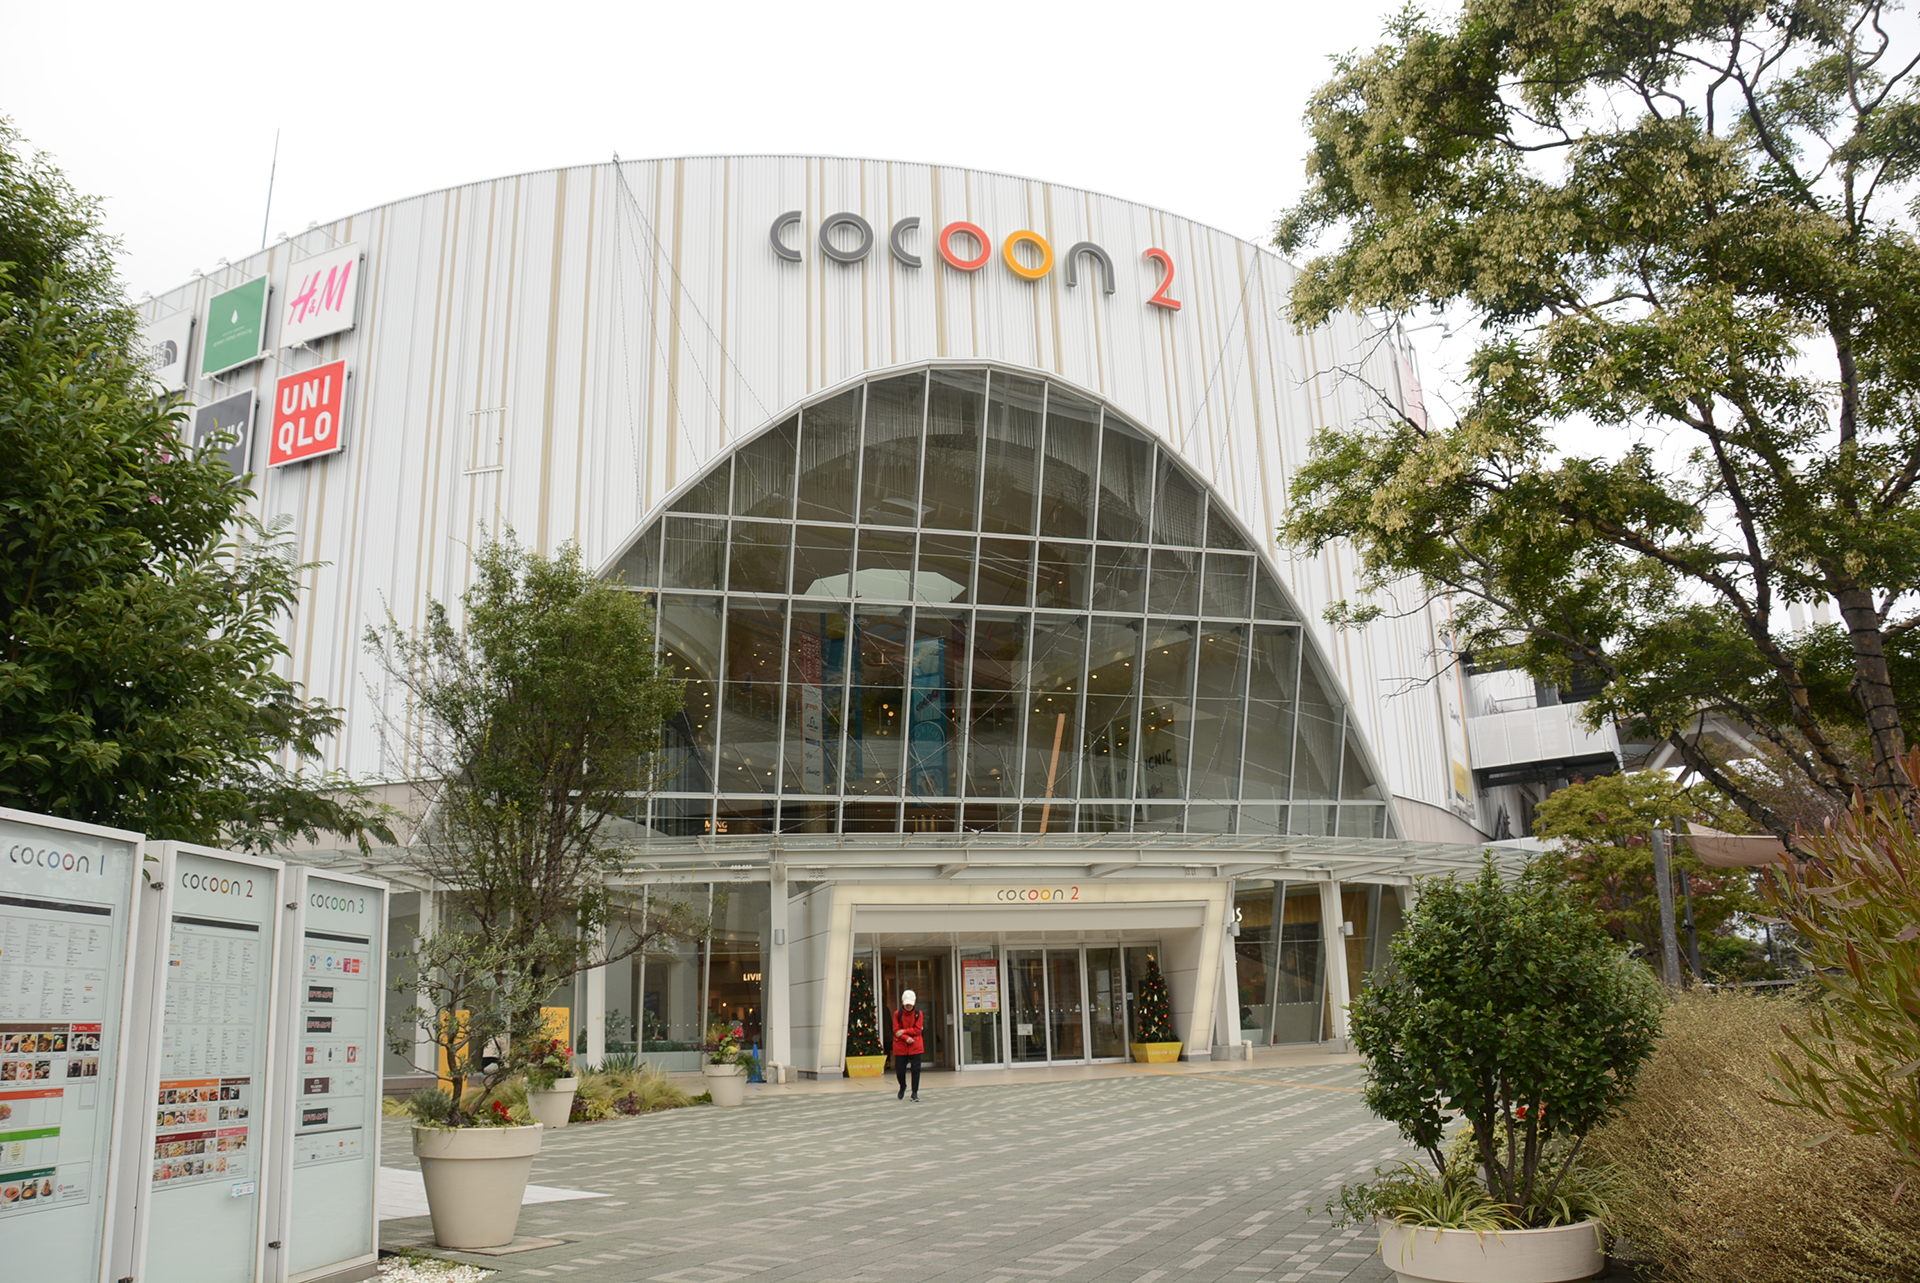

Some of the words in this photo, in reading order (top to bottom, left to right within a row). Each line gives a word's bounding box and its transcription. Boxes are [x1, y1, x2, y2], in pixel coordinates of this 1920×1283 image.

[1141, 246, 1182, 313] 2
[287, 259, 353, 326] H&M
[151, 340, 166, 354] THE
[281, 374, 331, 416] UNI
[277, 410, 332, 456] QLO
[704, 820, 728, 828] MNG
[246, 879, 254, 898] 2
[1070, 886, 1079, 900] 2
[358, 898, 365, 915] 3
